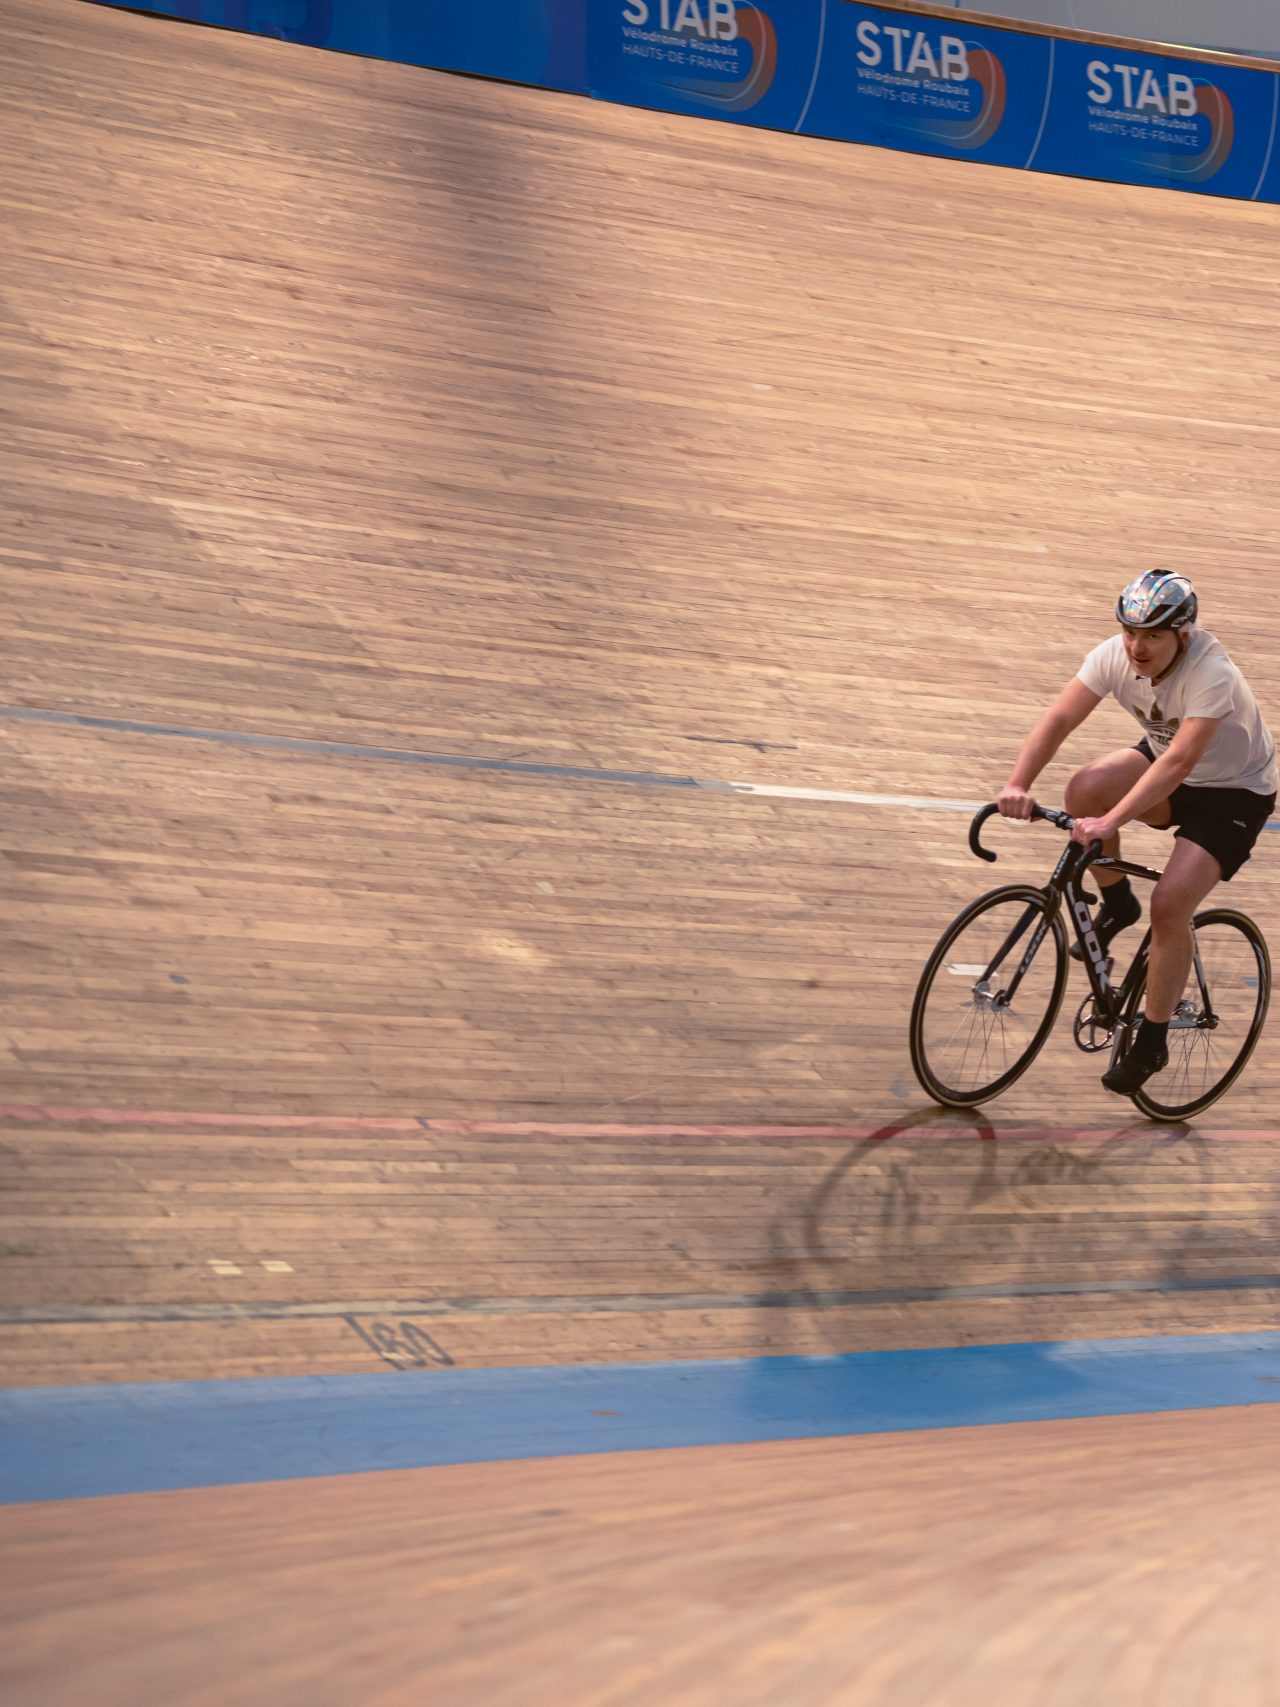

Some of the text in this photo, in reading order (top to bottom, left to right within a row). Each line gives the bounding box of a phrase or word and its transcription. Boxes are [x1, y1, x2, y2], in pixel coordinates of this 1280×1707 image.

[622, 43, 739, 74] HAUTS-DE-FRANCE
[689, 38, 738, 56] Roubaix
[856, 20, 969, 81] STAB
[857, 83, 971, 112] HAUTS-DE-FRANCE
[923, 79, 970, 96] Roubaix
[1087, 60, 1197, 117] STAB
[1088, 121, 1199, 147] HAUTS-DE-FRANCE
[1151, 115, 1198, 131] Roubaix
